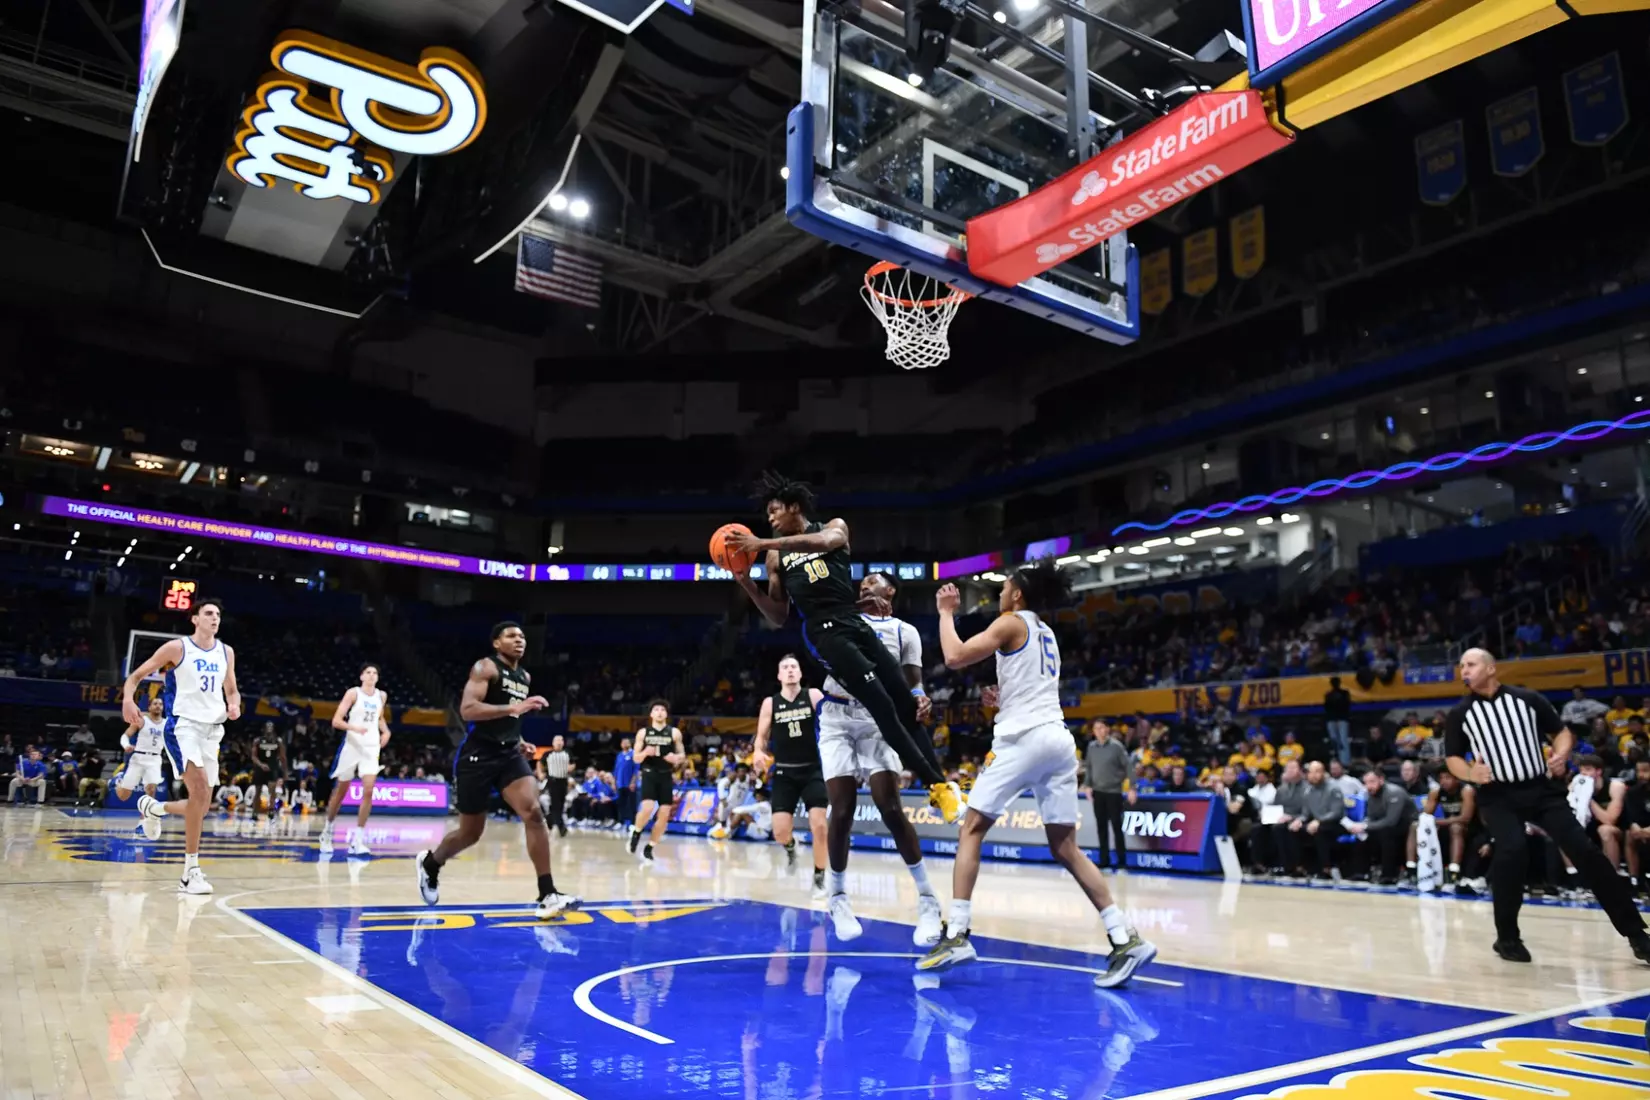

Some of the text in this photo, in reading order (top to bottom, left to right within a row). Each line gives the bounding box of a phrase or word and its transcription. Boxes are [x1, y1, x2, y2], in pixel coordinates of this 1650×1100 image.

[228, 38, 486, 204] Pitt
[67, 503, 88, 515] THE
[89, 506, 136, 522] OFFICIAL
[137, 513, 175, 528] HEALTH
[177, 519, 203, 532] CARE
[205, 523, 252, 538] PROVIDER
[253, 530, 275, 542] AND
[275, 533, 310, 546] HEALTH
[478, 559, 526, 579] UPMC
[804, 559, 830, 584] 10
[165, 589, 191, 610] 26
[193, 658, 219, 672] Pitt
[1038, 631, 1057, 678] 15
[1605, 651, 1650, 687] PA
[80, 684, 110, 704] THE
[200, 675, 215, 693] 31
[1247, 682, 1281, 706] ZOO
[349, 786, 399, 801] UMC
[1136, 853, 1173, 869] UPMC
